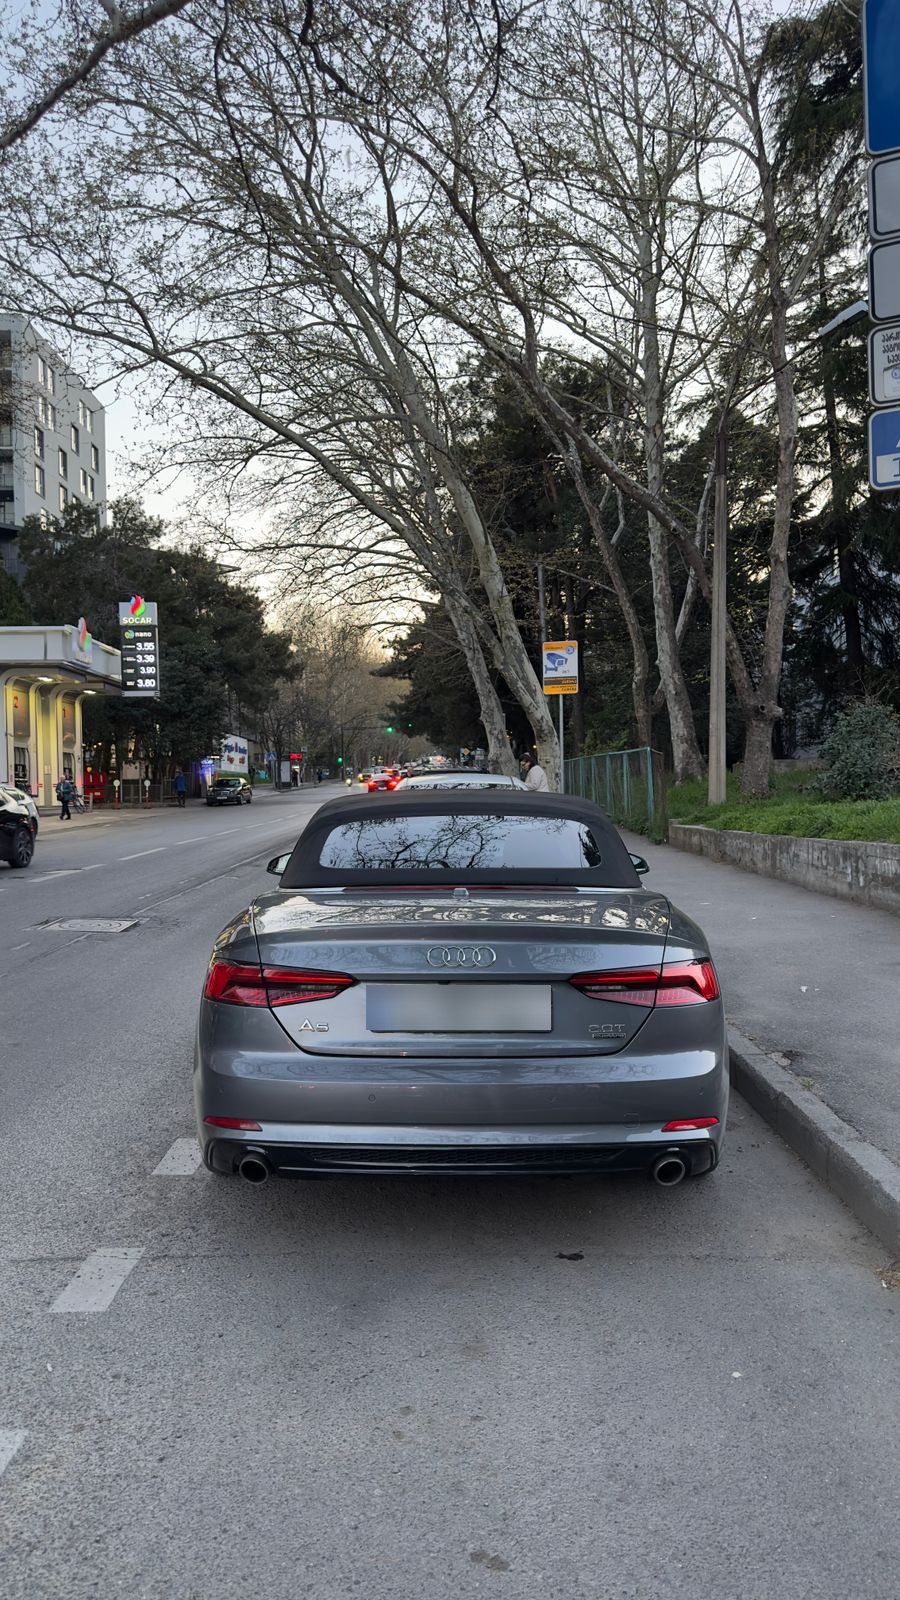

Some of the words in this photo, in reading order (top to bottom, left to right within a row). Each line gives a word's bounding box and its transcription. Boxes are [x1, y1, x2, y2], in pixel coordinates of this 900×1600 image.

[122, 616, 152, 625] SOCAR
[136, 642, 155, 651] 3.55
[136, 654, 155, 663] 3.39
[140, 666, 156, 674] 3.90
[136, 678, 156, 688] 3.80
[298, 1017, 330, 1033] A5
